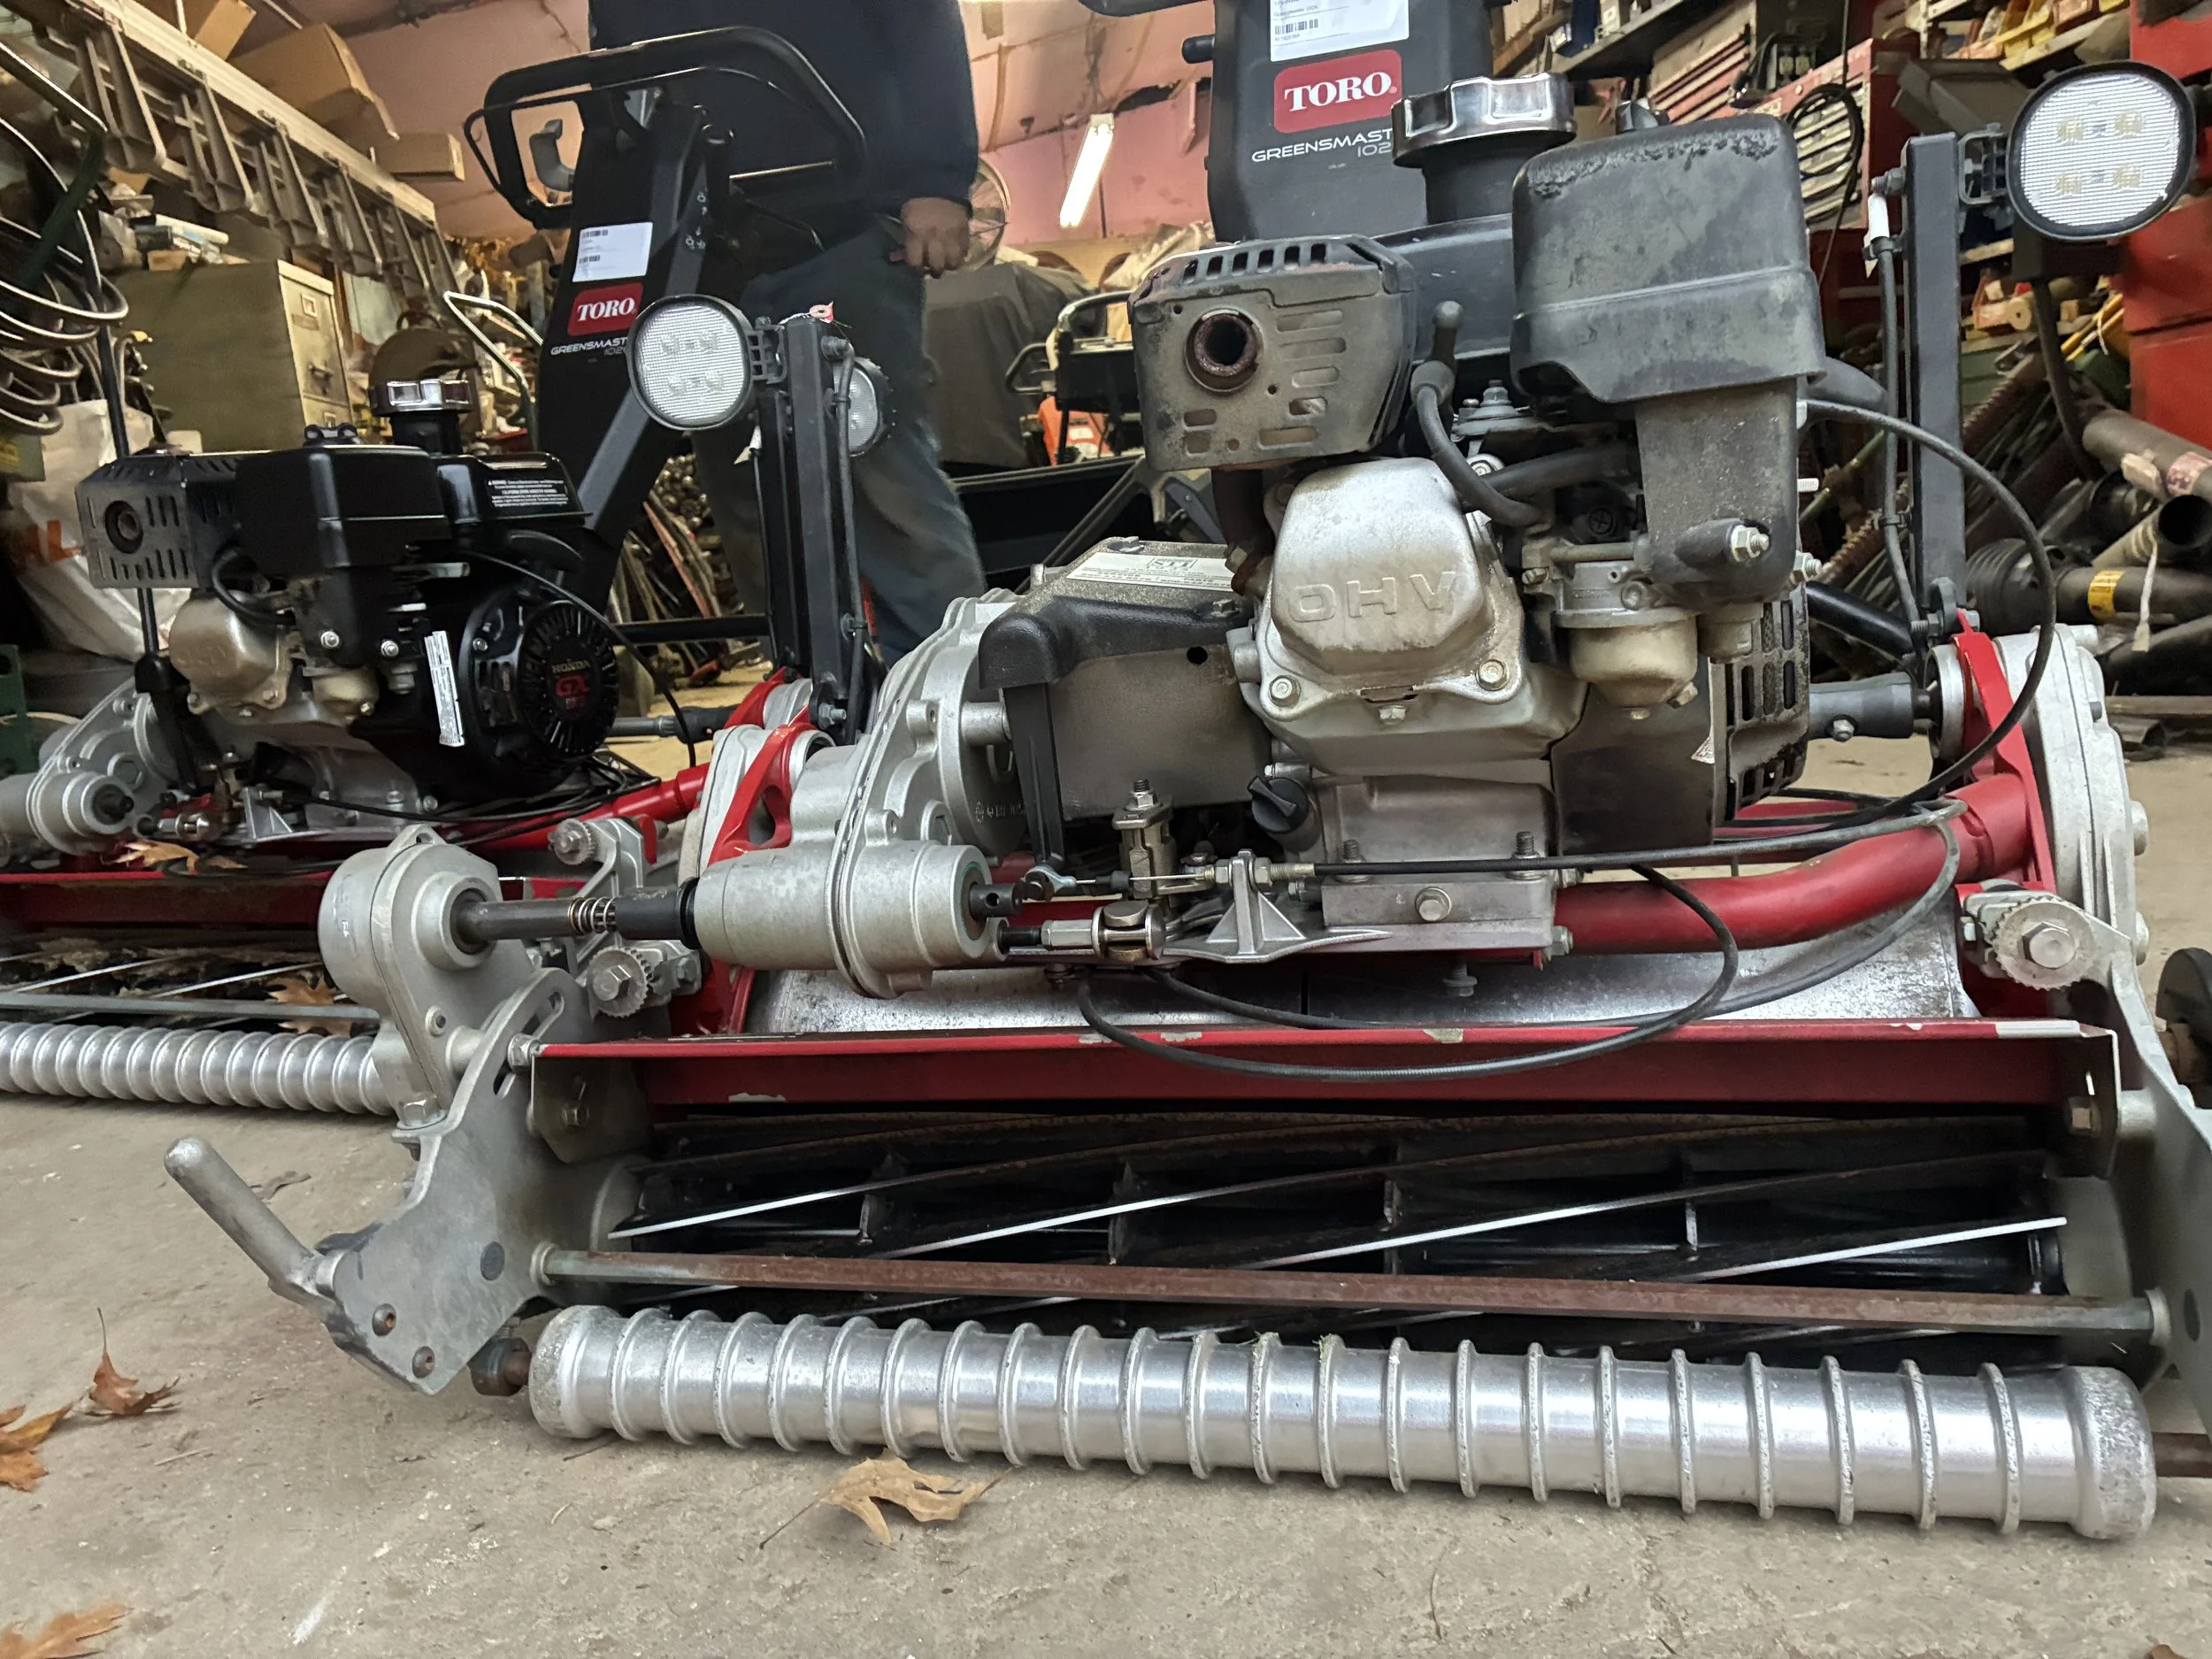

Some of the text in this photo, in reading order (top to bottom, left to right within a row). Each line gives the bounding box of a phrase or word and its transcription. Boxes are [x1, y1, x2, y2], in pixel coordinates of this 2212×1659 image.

[1284, 72, 1392, 111] TORO
[1251, 128, 1393, 163] GREENSMAST
[1357, 142, 1392, 157] 102
[577, 297, 635, 322] TORO
[550, 337, 627, 356] GREENSMAST
[603, 346, 626, 357] 102
[1288, 571, 1458, 623] OHV
